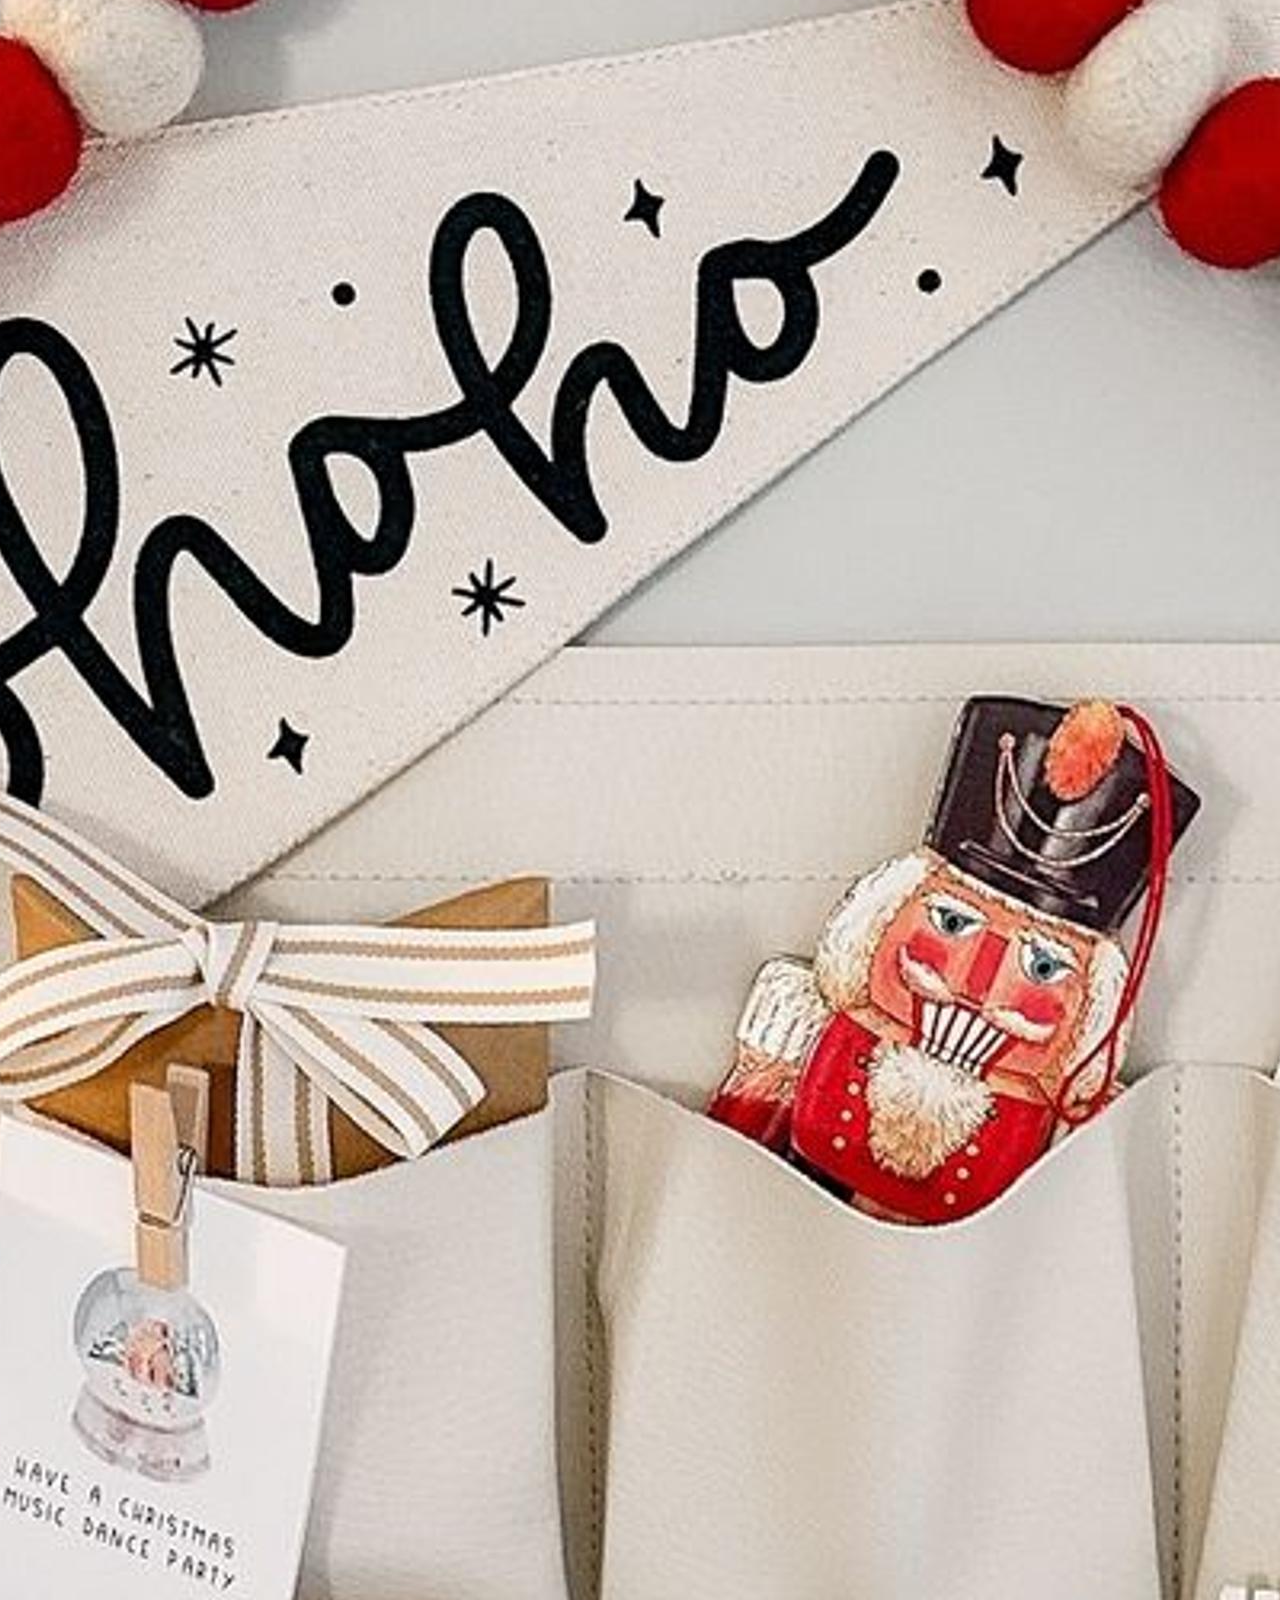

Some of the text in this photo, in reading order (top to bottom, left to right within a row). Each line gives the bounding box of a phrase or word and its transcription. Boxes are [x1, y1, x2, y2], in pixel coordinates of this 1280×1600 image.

[2, 1486, 236, 1590] MUSIC DANCE PARTY
[13, 1455, 236, 1560] HAVE A CHRISTMAS
